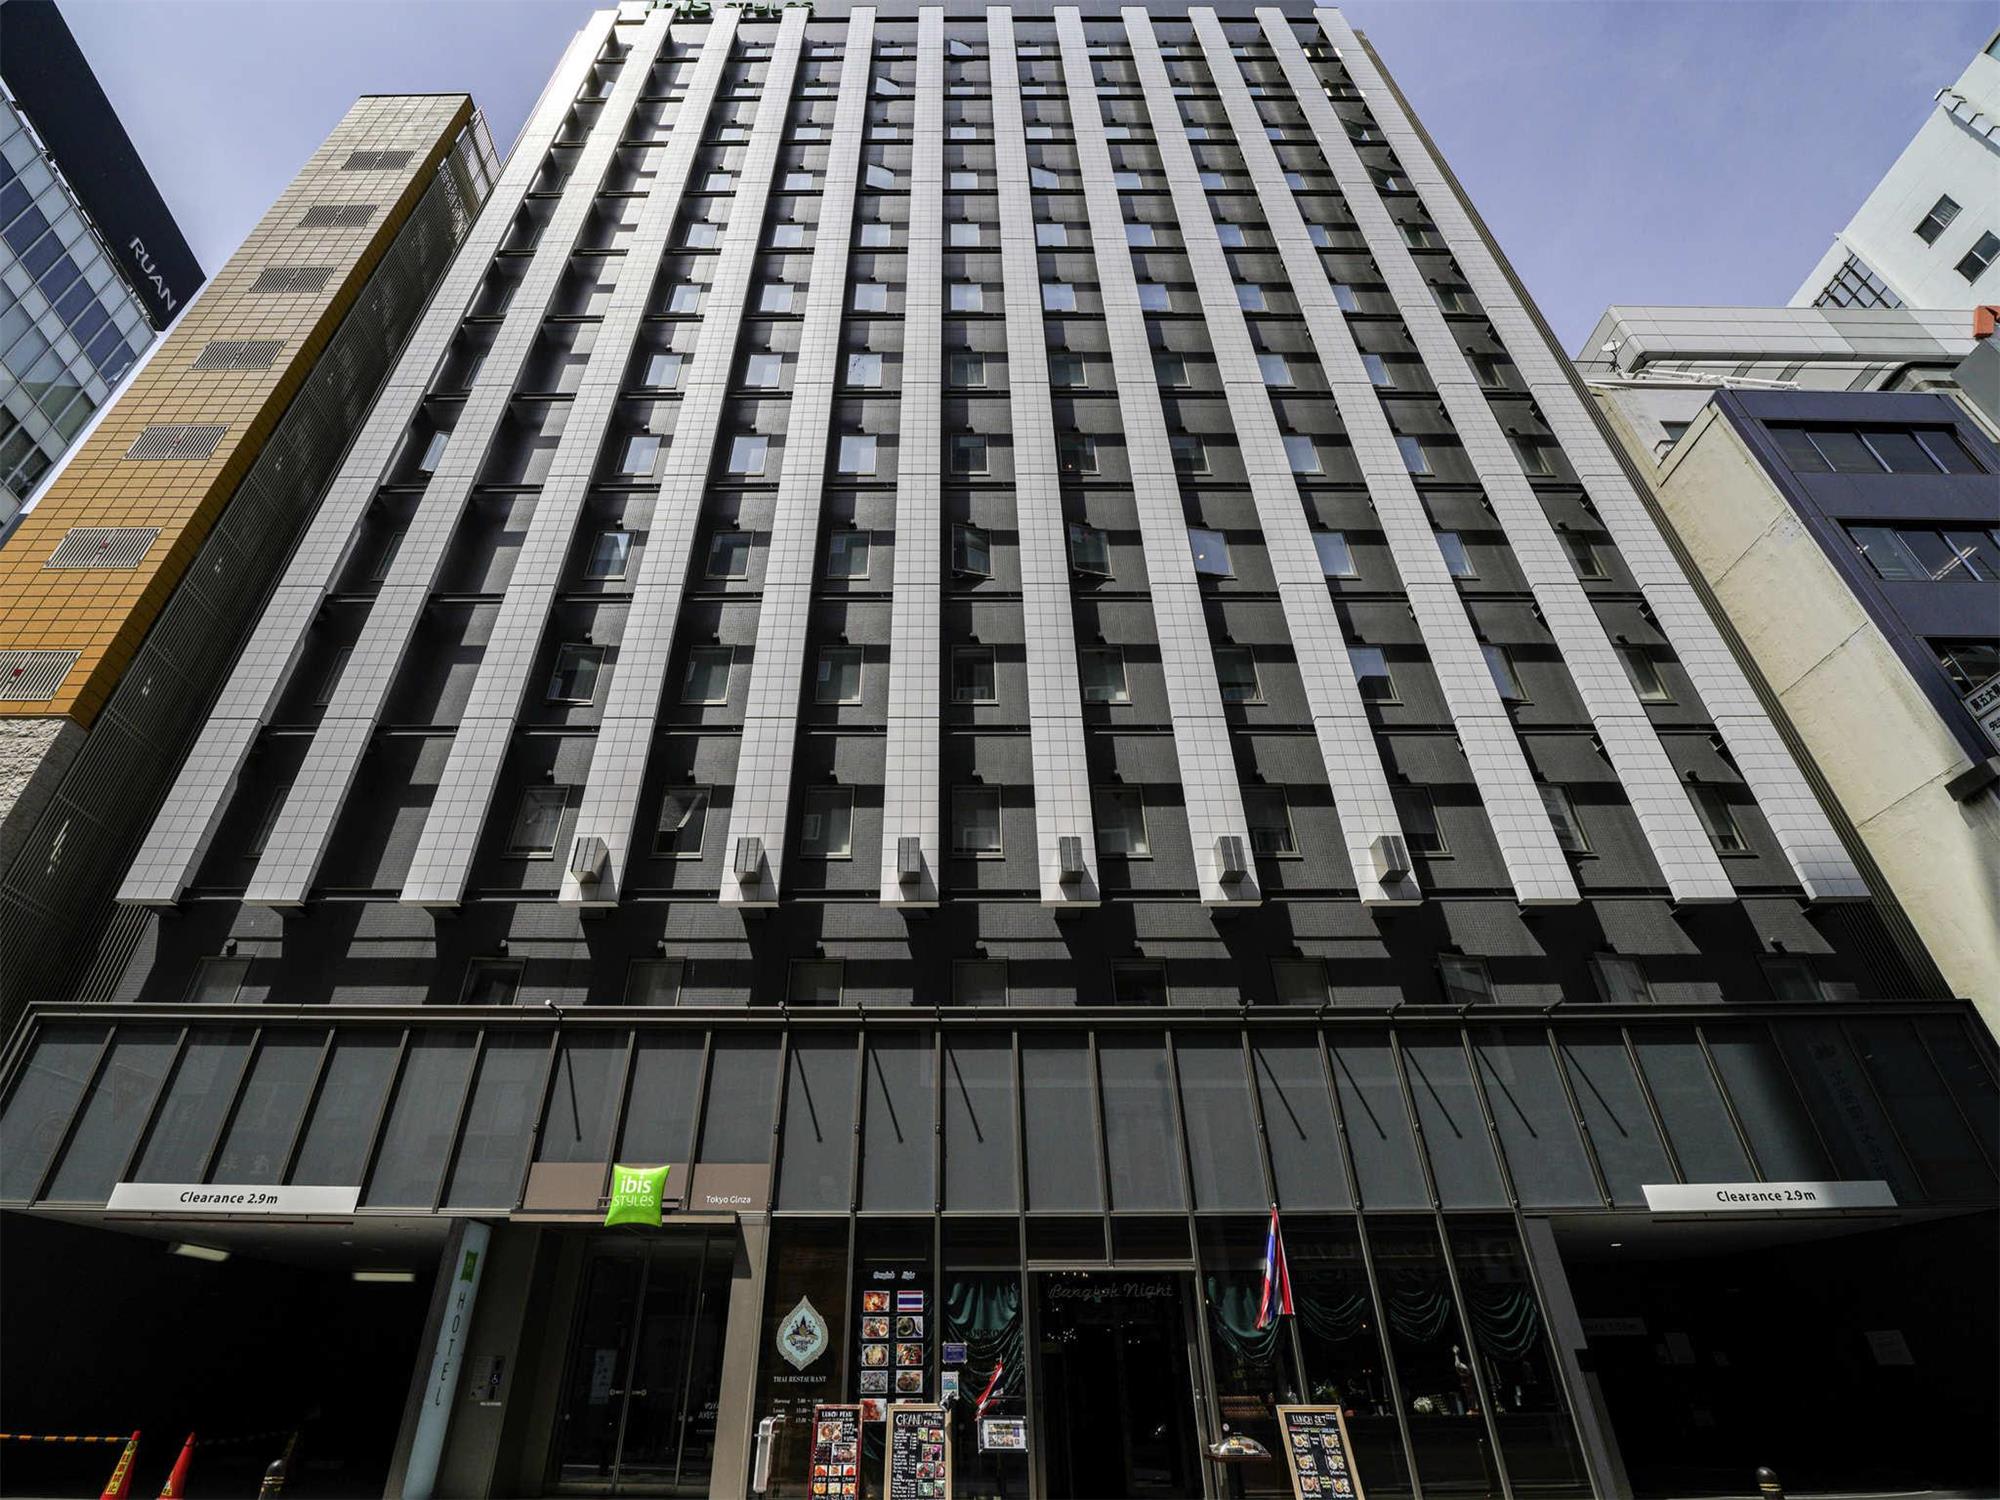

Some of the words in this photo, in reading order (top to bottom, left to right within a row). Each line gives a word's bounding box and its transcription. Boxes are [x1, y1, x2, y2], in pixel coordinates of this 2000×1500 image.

[129, 237, 177, 311] RUAN
[620, 1175, 652, 1194] ibis
[179, 1191, 244, 1204] Clearance
[706, 1195, 728, 1206] Tokyo
[729, 1195, 751, 1205] Ginza
[1716, 1190, 1782, 1203] Clearance
[1049, 1283, 1119, 1300] Bangkok
[1123, 1282, 1174, 1299] Night
[434, 1292, 466, 1407] HOTEL
[788, 1375, 826, 1383] RESTAURANT
[896, 1413, 923, 1425] GRAND
